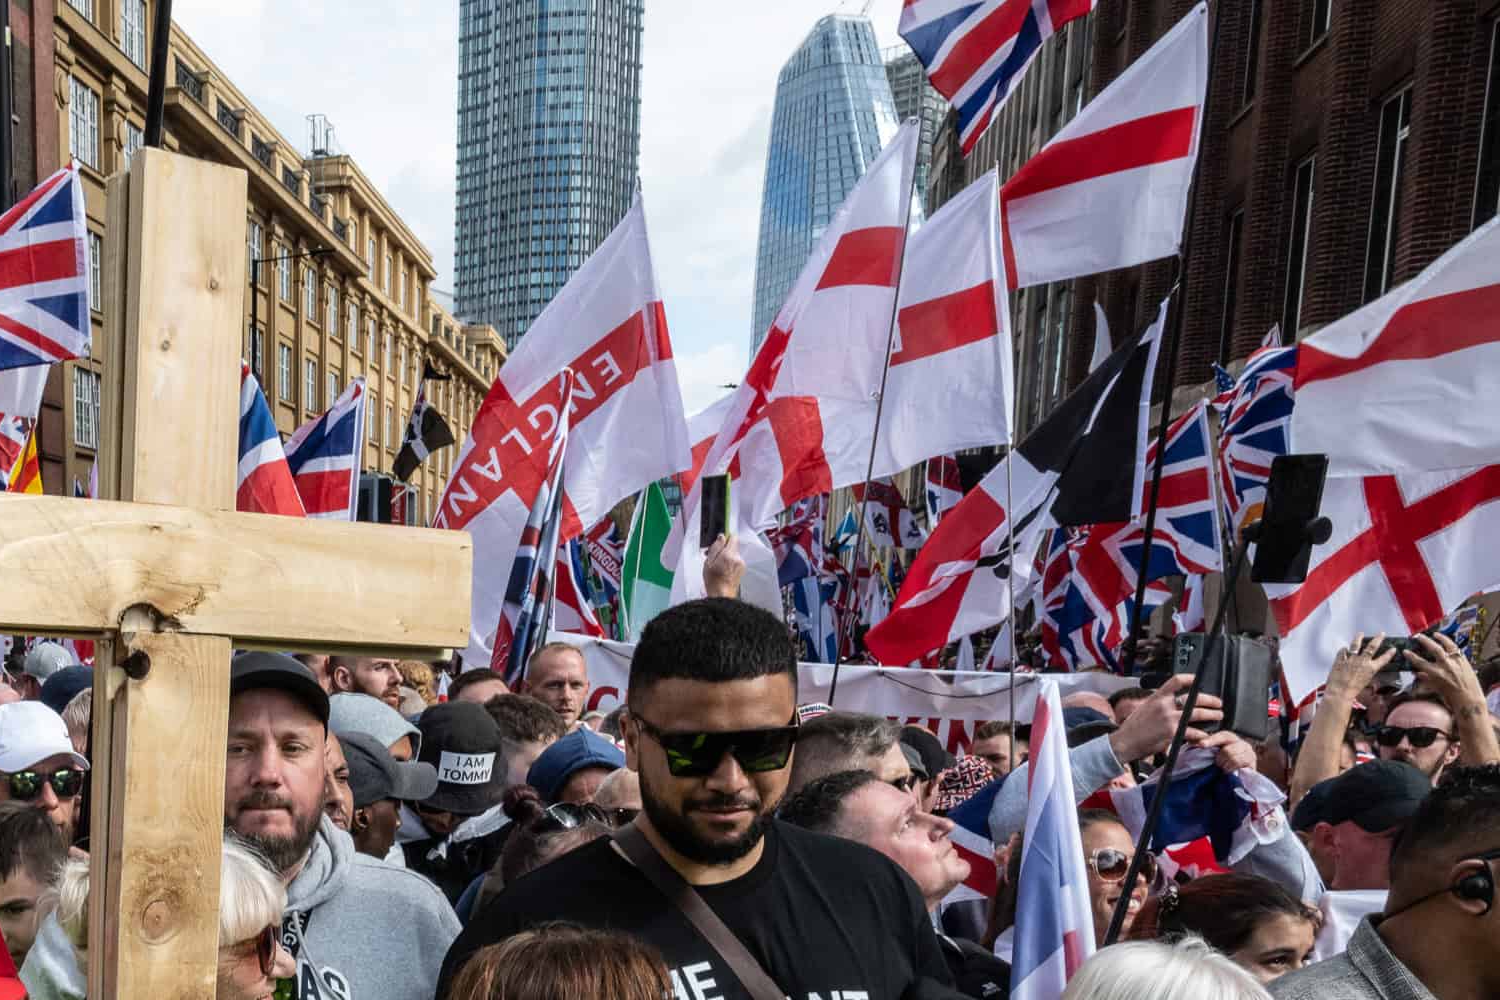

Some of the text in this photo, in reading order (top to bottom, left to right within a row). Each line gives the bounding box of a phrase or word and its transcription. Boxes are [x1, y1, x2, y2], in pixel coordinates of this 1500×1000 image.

[456, 756, 485, 768] I AM
[443, 767, 491, 782] TOMMY
